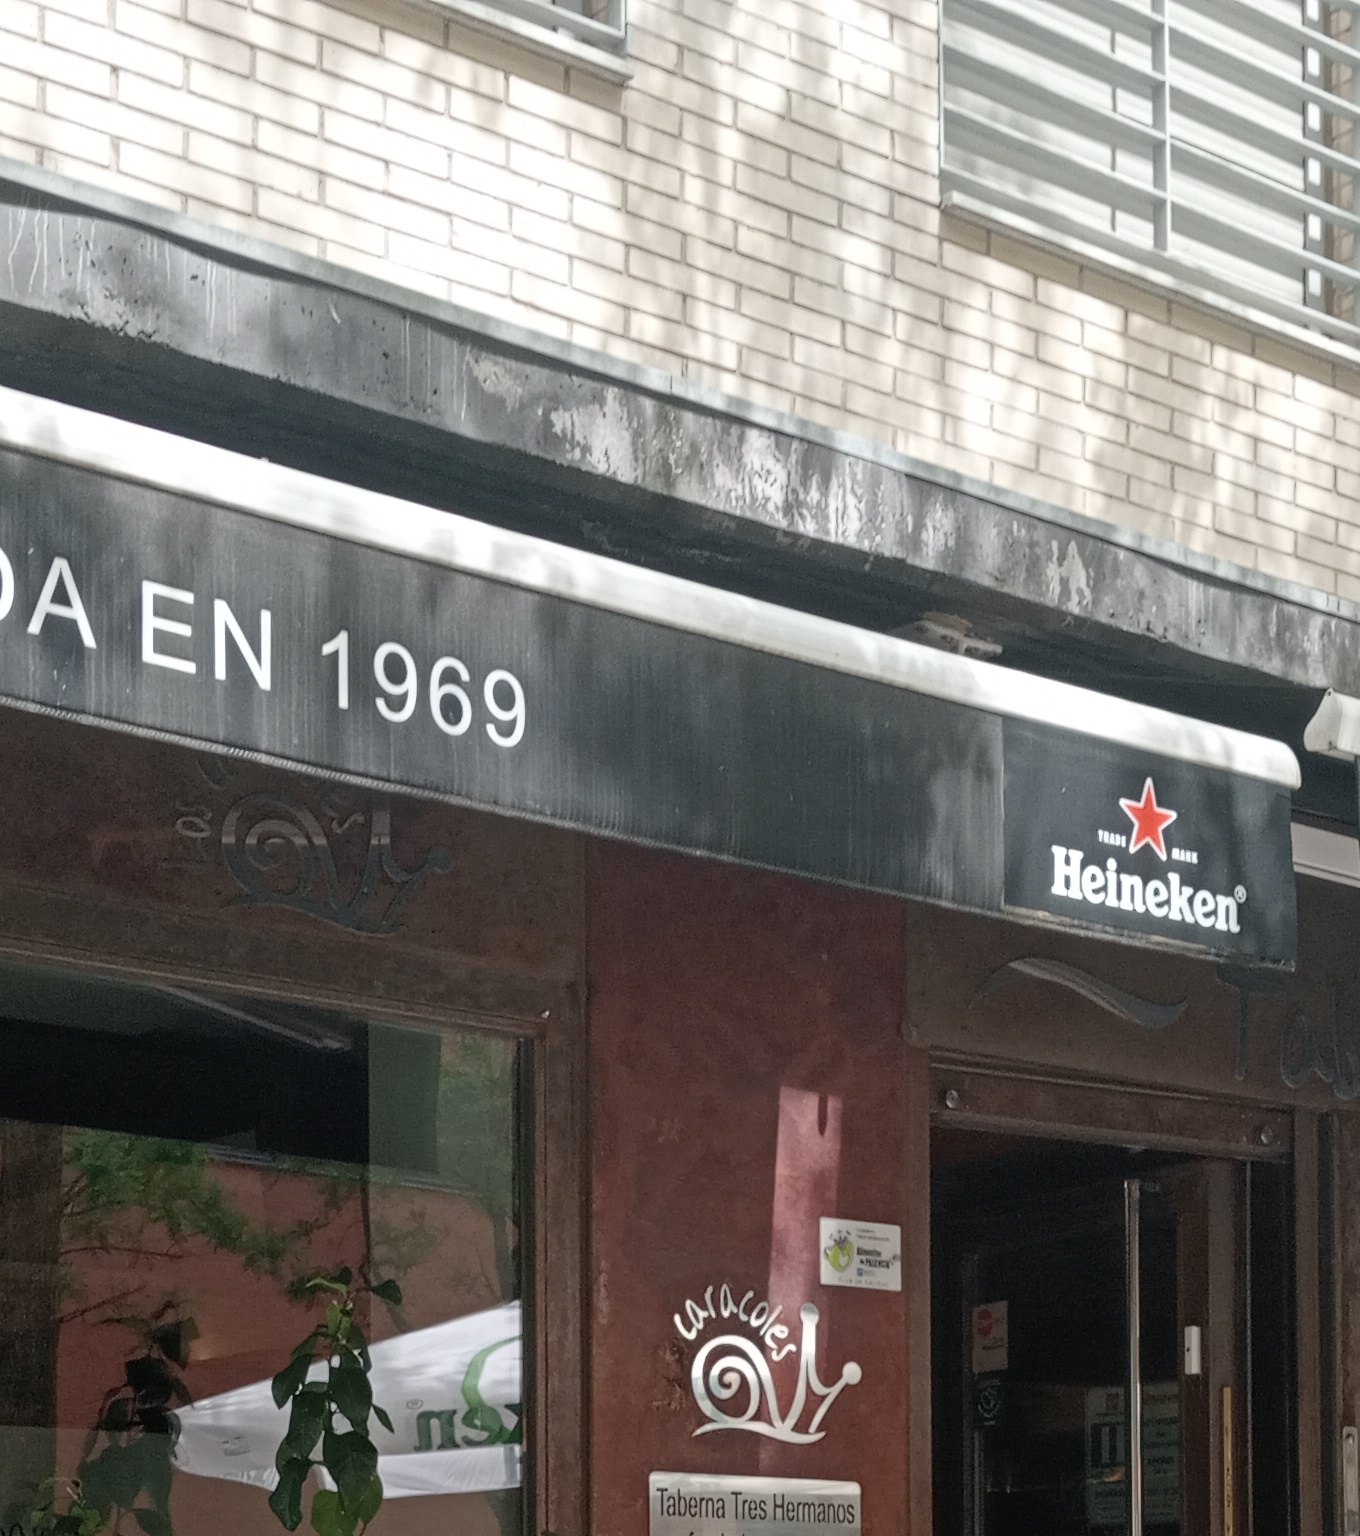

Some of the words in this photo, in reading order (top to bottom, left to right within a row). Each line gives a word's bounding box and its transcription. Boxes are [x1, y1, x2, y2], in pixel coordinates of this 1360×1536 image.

[140, 578, 273, 693] EN
[320, 629, 527, 750] 1969
[1096, 828, 1127, 849] TRADE
[1049, 843, 1242, 934] Heineken
[672, 1283, 797, 1362] caracoles
[657, 1487, 727, 1524] Taberna
[731, 1490, 768, 1525] Tres
[772, 1491, 856, 1526] Hermanos
